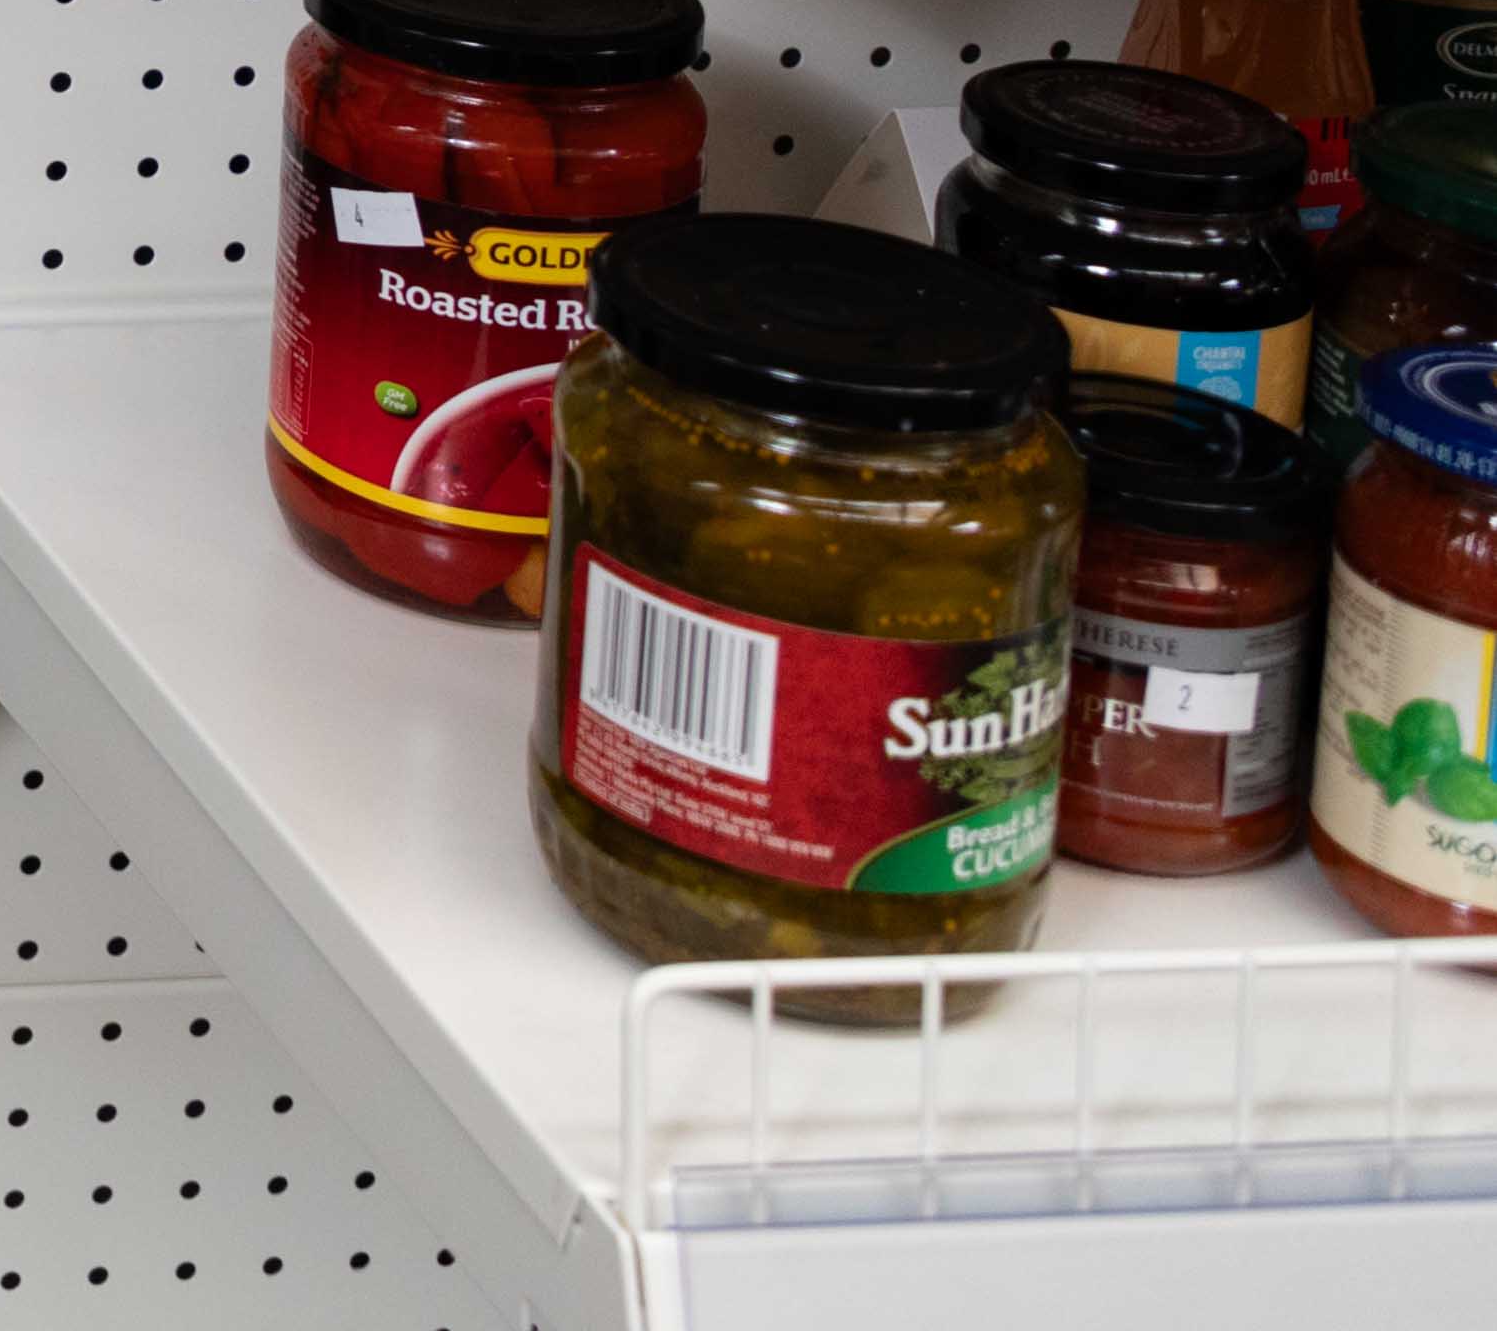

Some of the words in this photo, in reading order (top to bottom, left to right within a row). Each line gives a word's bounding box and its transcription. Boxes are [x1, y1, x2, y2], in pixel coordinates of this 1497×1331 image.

[378, 268, 547, 331] Roasted
[382, 397, 408, 412] Free
[386, 387, 406, 401] GM
[1177, 685, 1192, 710] 2
[946, 810, 1020, 851] Bread
